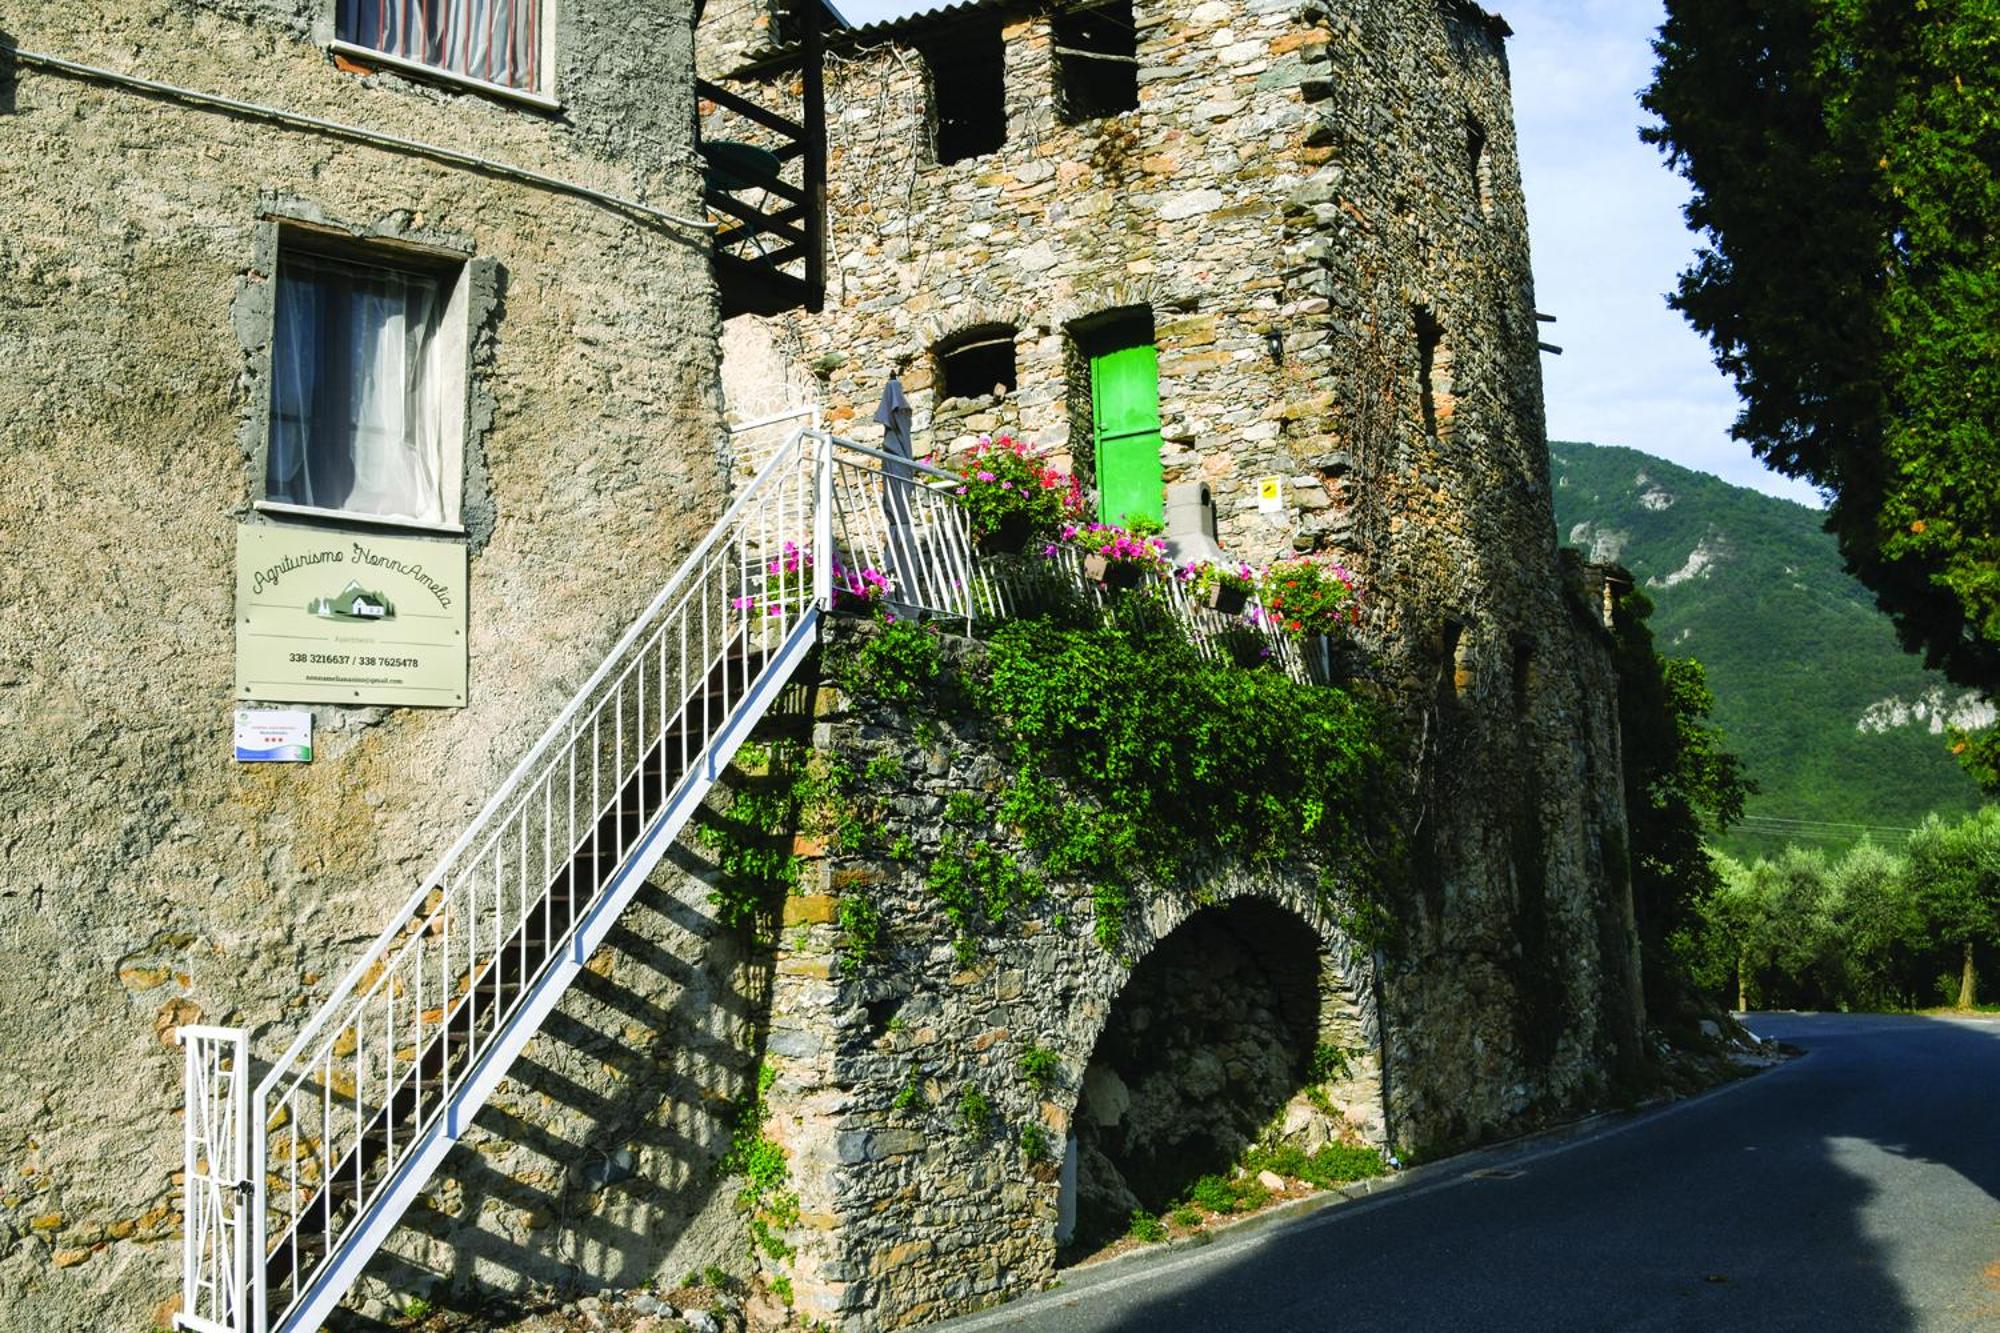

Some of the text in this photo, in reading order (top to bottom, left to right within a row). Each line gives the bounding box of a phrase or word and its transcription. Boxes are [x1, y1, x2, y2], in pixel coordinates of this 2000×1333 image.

[252, 550, 344, 595] Agriturismo
[289, 652, 308, 663] 338
[359, 656, 377, 666] 338
[378, 657, 419, 668] 7625478
